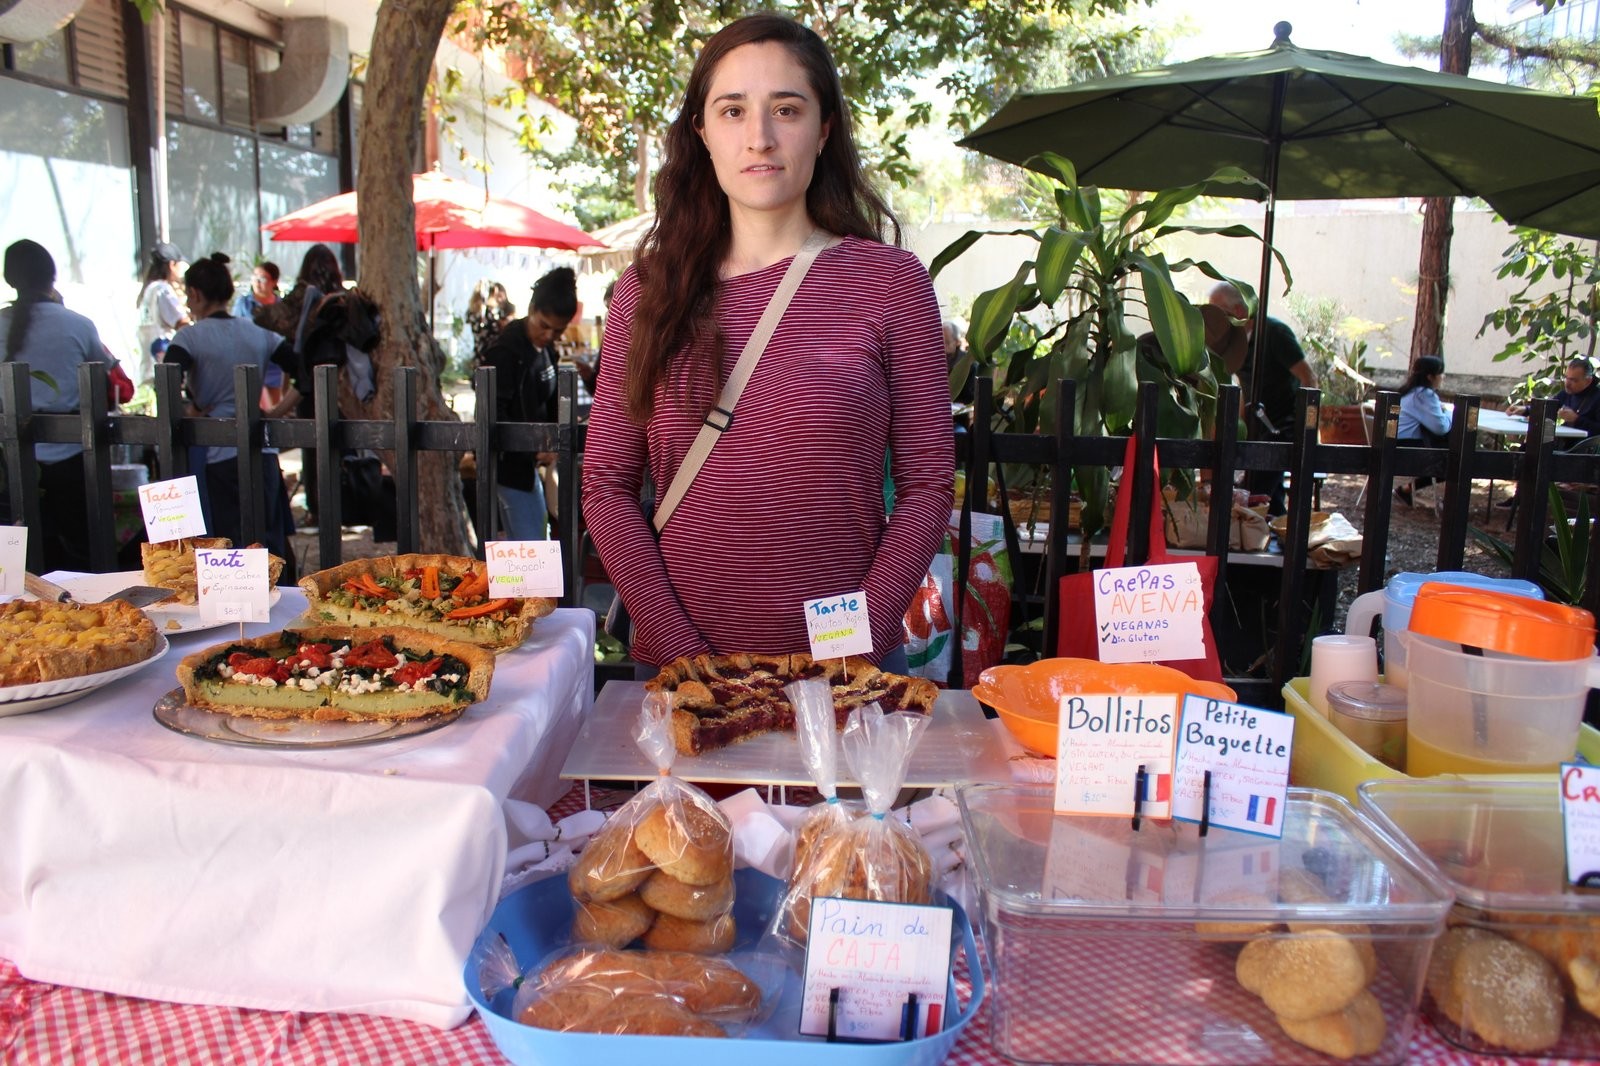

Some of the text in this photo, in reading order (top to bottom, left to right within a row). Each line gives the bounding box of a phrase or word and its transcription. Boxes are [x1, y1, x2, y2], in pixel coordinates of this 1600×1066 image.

[198, 550, 245, 567] Tarte
[809, 597, 859, 615] Tarte
[1111, 590, 1199, 615] AVENA
[817, 628, 853, 641] VEGANA
[1113, 619, 1169, 631] VEGANAS
[1128, 632, 1160, 643] Gluten
[1068, 696, 1171, 734] Bollitos
[1206, 700, 1257, 729] Petite
[820, 899, 929, 937] Pain de
[826, 938, 901, 970] CAJA
